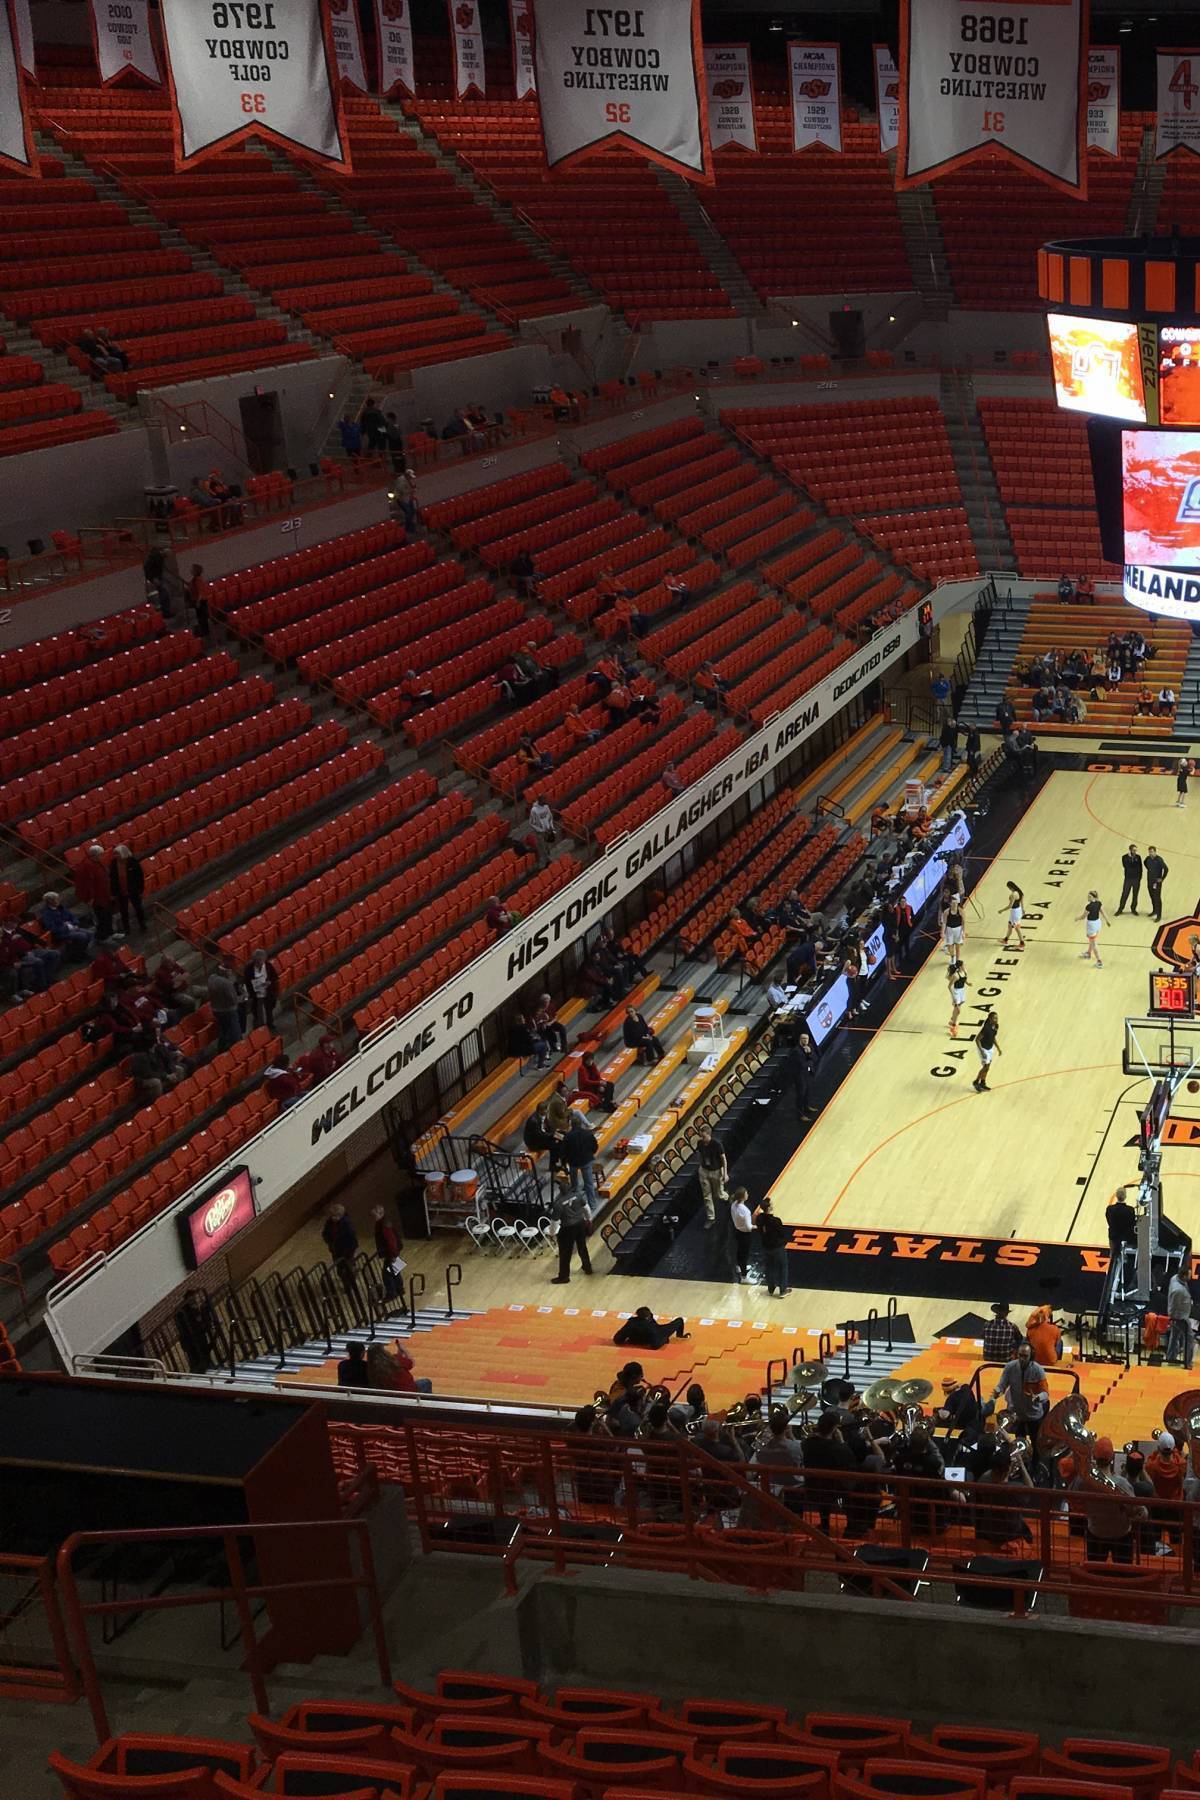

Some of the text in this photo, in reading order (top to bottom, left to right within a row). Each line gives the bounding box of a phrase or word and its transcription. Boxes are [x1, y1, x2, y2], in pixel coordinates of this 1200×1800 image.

[793, 62, 835, 71] CHAMPIONS
[1088, 109, 1104, 119] 933
[1141, 327, 1157, 388] Hertz
[281, 516, 302, 533] 213
[1043, 837, 1088, 888] ARENA
[311, 1021, 436, 1145] WELCOME
[443, 991, 474, 1030] TO
[507, 869, 618, 982] HISTORIC
[626, 743, 769, 879] GALLAGHER-IBA
[776, 702, 820, 753] ARENA
[833, 653, 881, 701] DEDICATED
[784, 1229, 1041, 1267] STATE
